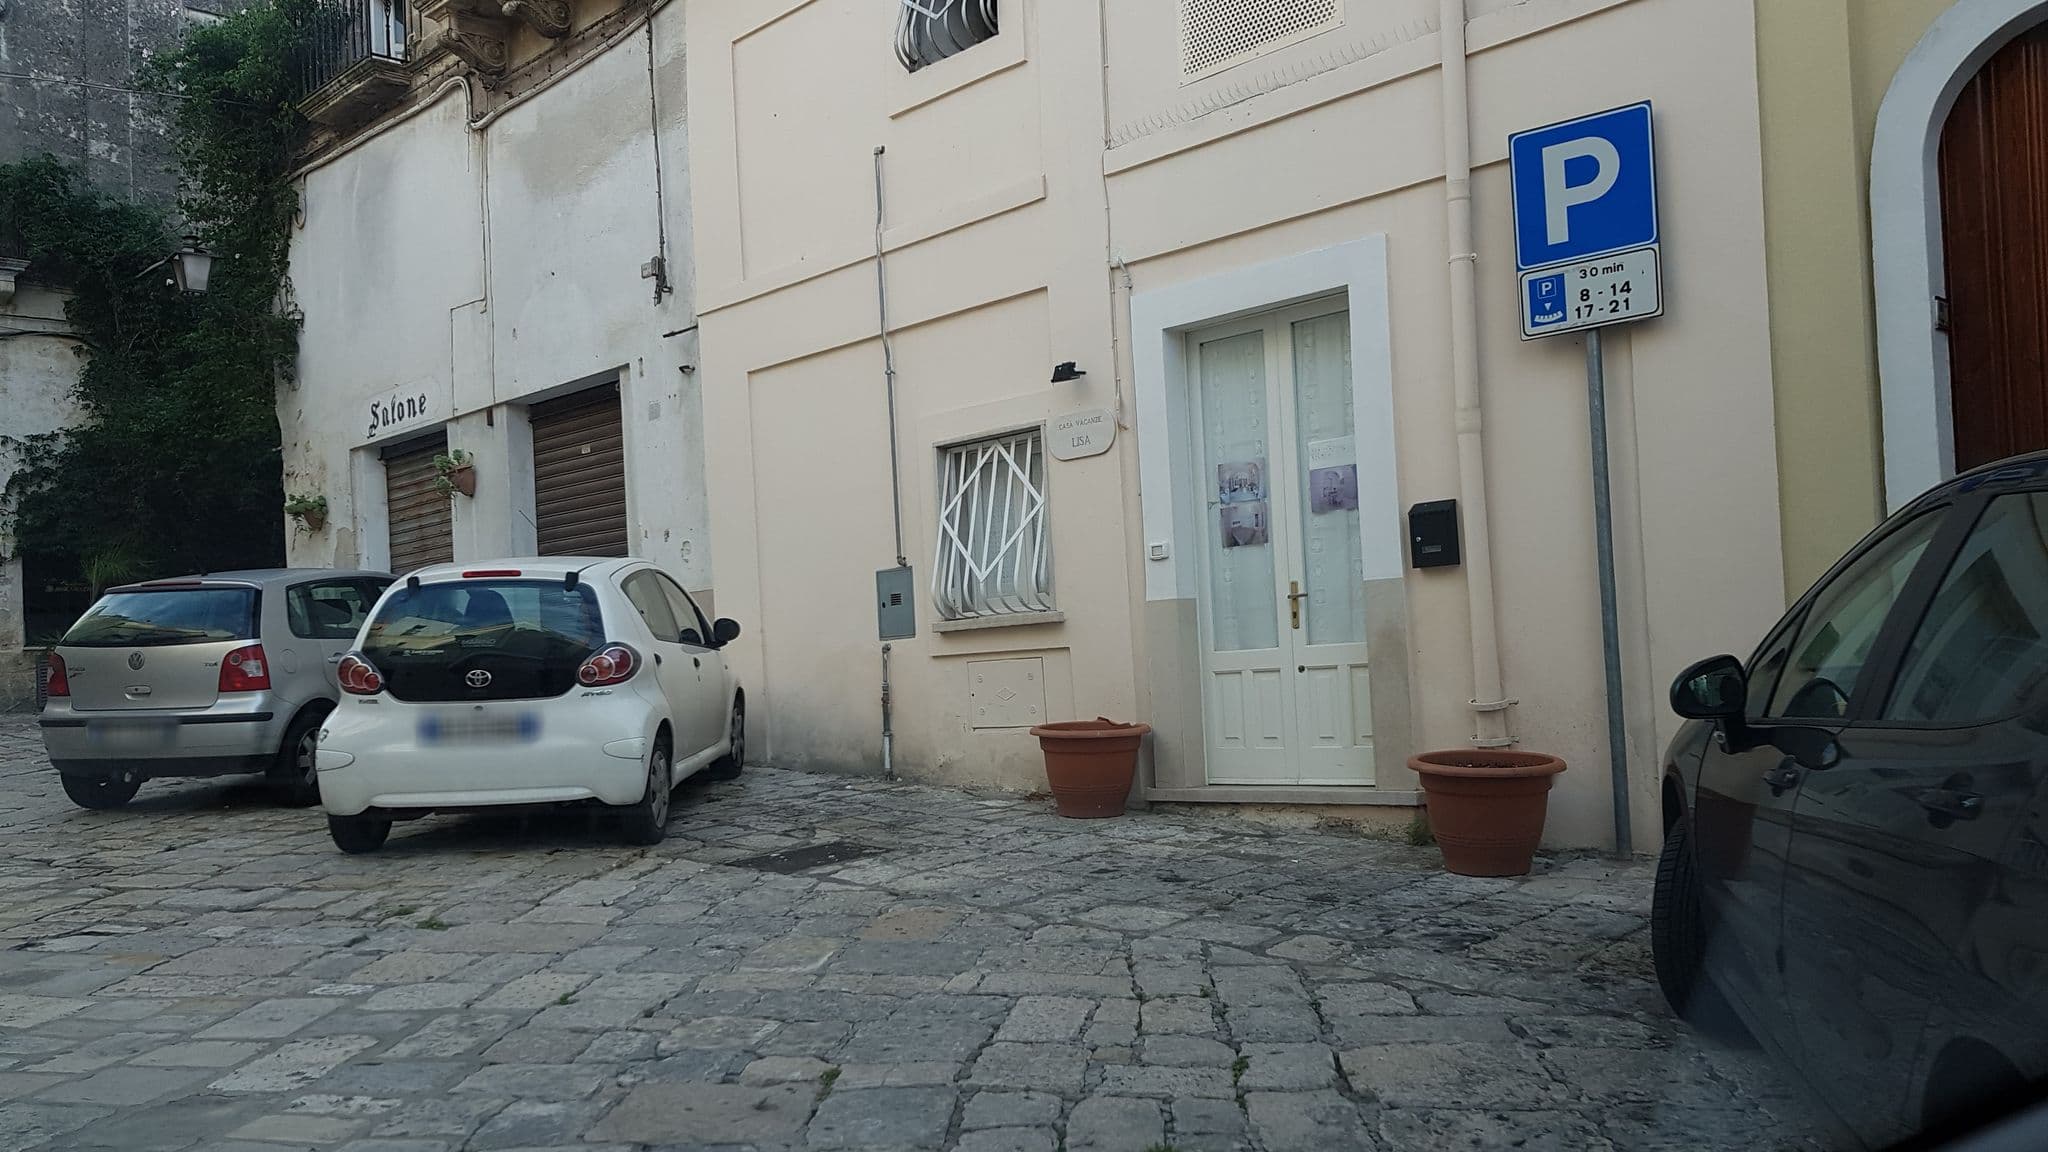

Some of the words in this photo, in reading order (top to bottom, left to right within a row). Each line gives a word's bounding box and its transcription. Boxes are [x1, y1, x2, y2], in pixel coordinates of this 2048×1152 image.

[1542, 136, 1620, 246] P
[1580, 267, 1598, 279] 30
[1602, 262, 1624, 275] min
[1541, 282, 1552, 295] P
[1580, 288, 1590, 301] 8
[1610, 280, 1632, 296] 14
[367, 393, 426, 439] Salone
[1072, 435, 1091, 447] LISA
